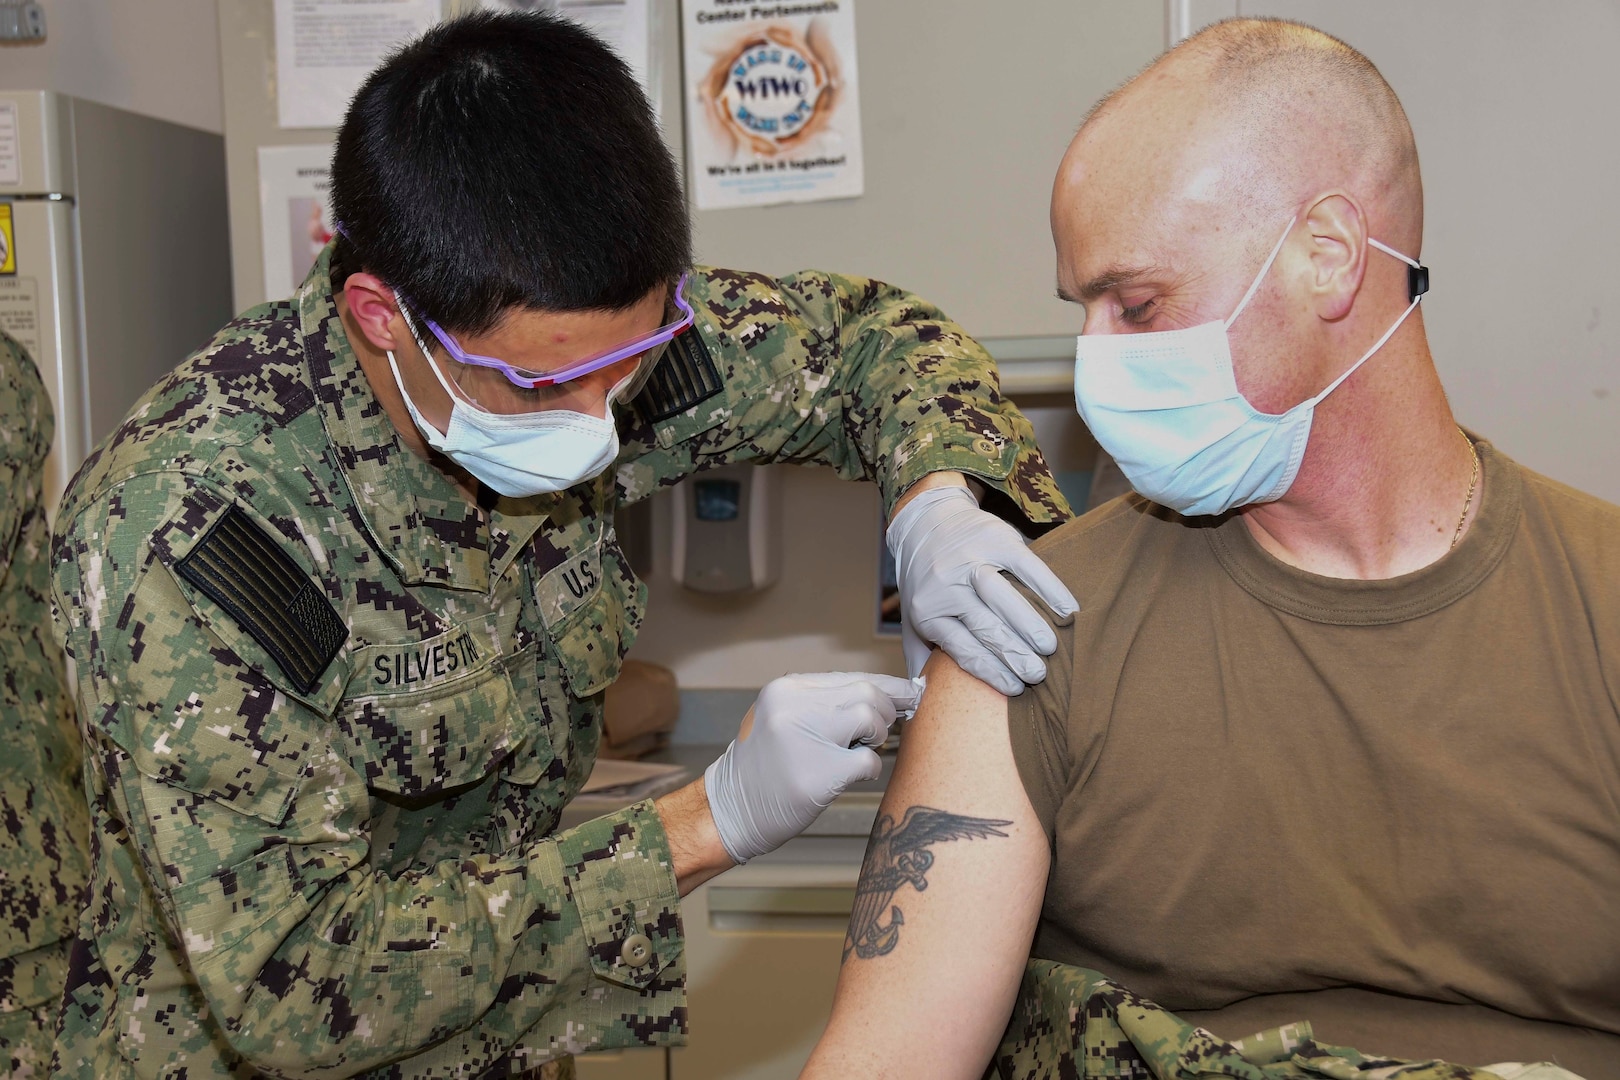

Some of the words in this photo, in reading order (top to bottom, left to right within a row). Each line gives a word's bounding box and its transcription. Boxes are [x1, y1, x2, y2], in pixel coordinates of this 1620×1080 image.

[696, 8, 746, 24] Center
[750, 1, 839, 20] Portsmouth
[735, 75, 809, 100] WIWO
[789, 154, 847, 171] together!
